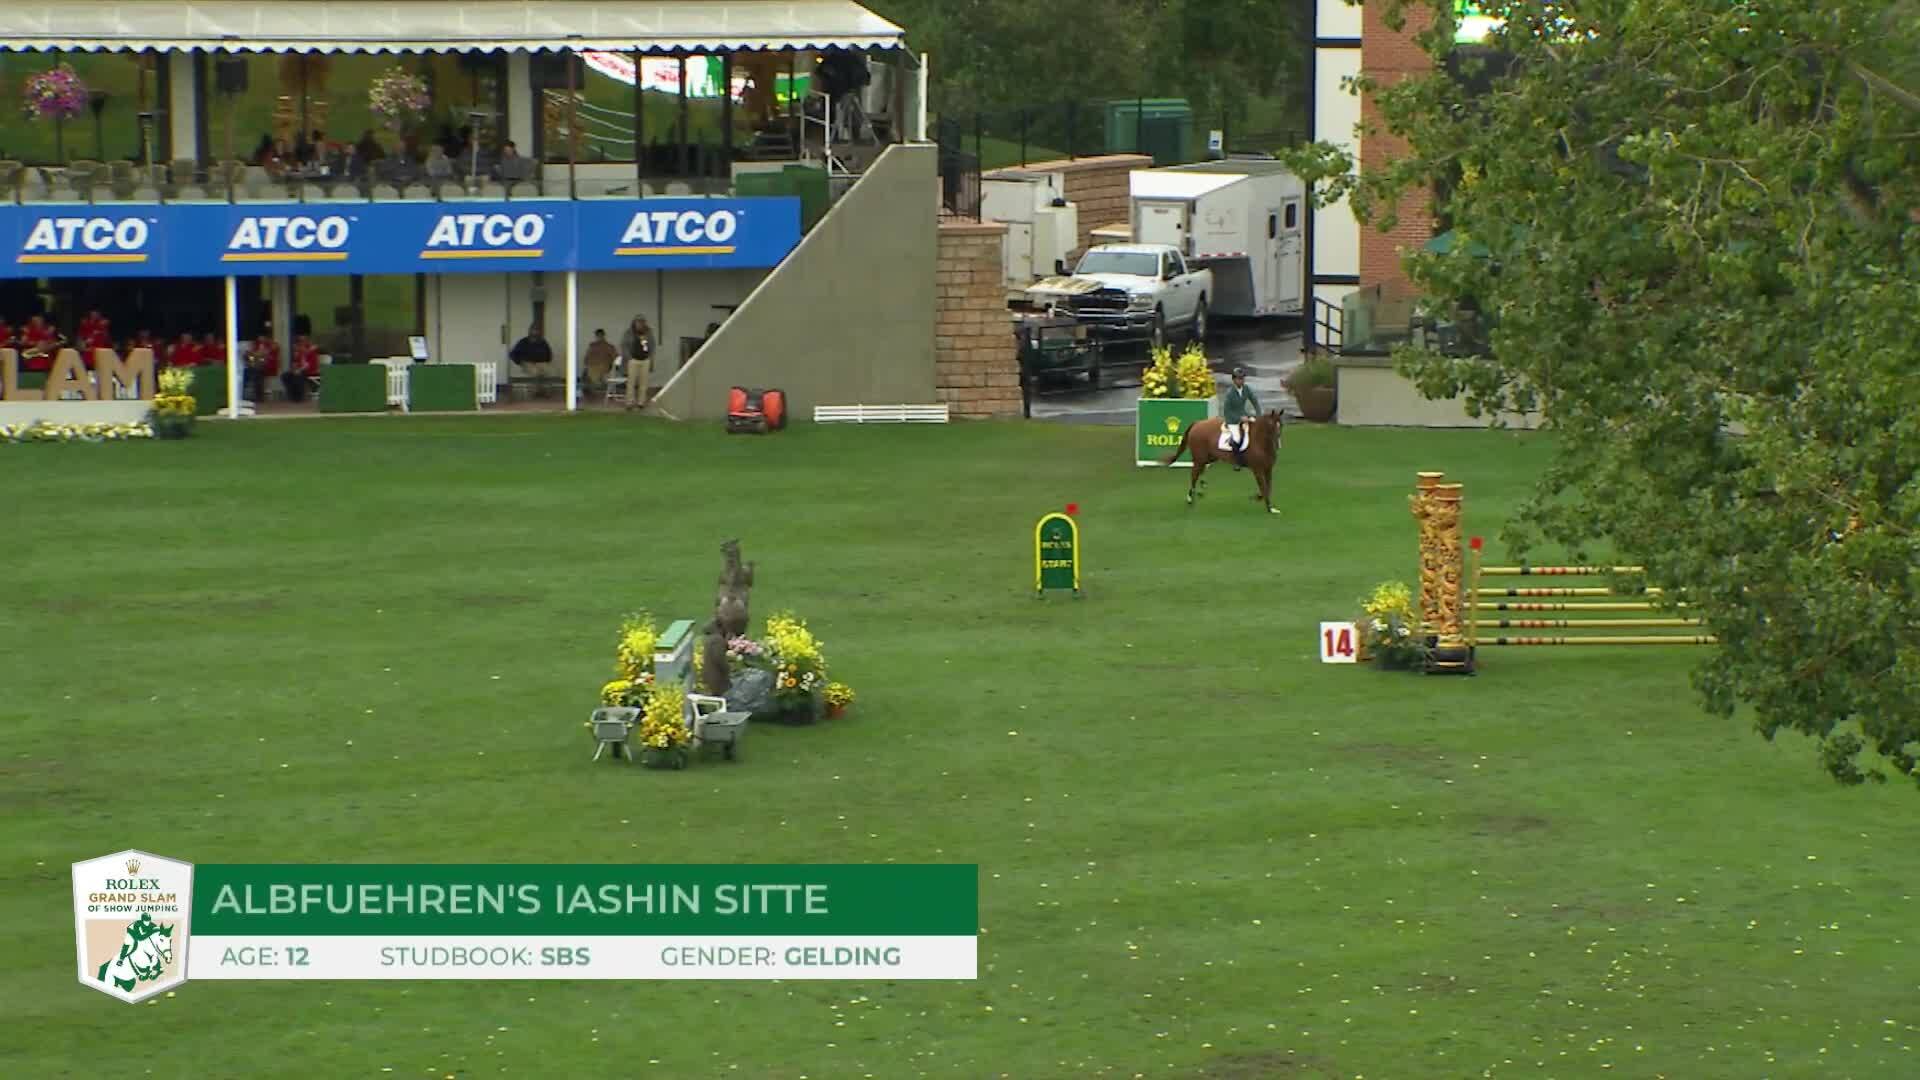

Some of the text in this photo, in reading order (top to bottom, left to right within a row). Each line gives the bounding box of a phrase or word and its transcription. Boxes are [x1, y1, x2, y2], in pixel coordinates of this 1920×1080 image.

[24, 217, 149, 251] ATCO
[229, 215, 348, 249] ATCO
[428, 213, 545, 247] ATCO
[621, 210, 736, 244] ATCO
[1324, 628, 1354, 657] 14
